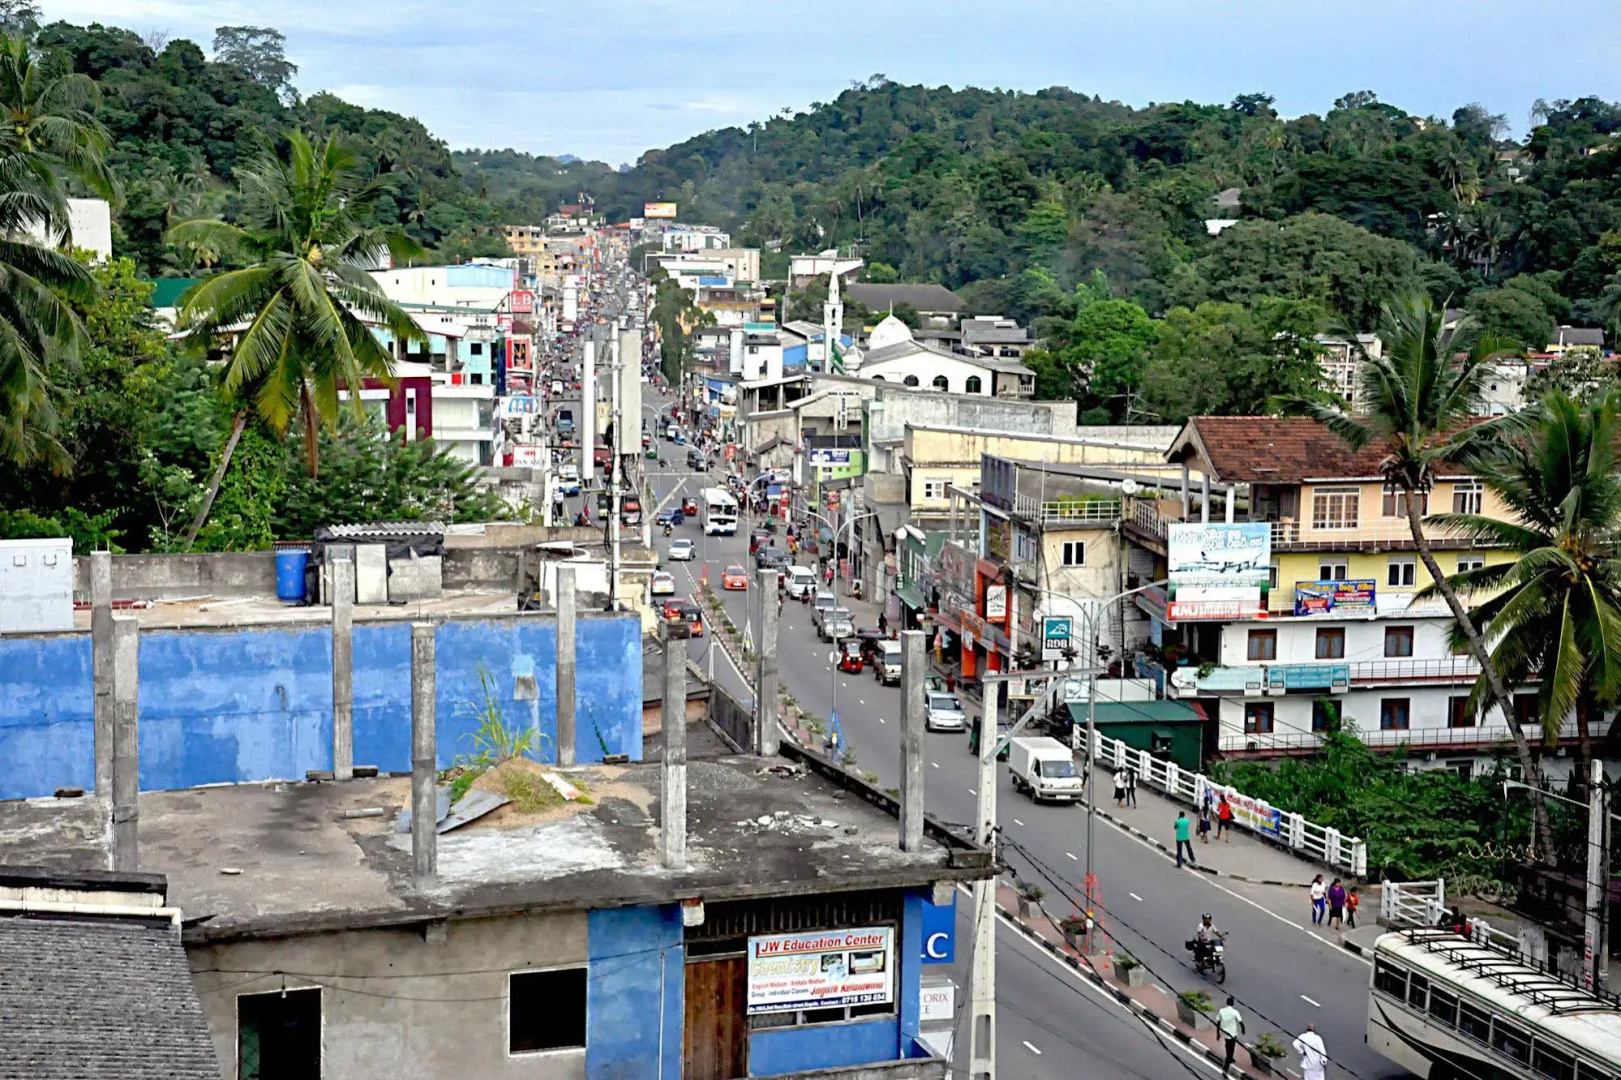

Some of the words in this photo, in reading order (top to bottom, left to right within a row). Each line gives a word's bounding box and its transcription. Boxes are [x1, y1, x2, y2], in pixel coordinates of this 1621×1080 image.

[1046, 639, 1068, 649] RDB
[783, 938, 841, 951] Education
[845, 934, 884, 946] Center
[750, 956, 819, 977] Chemistry
[923, 993, 949, 1004] ORIX
